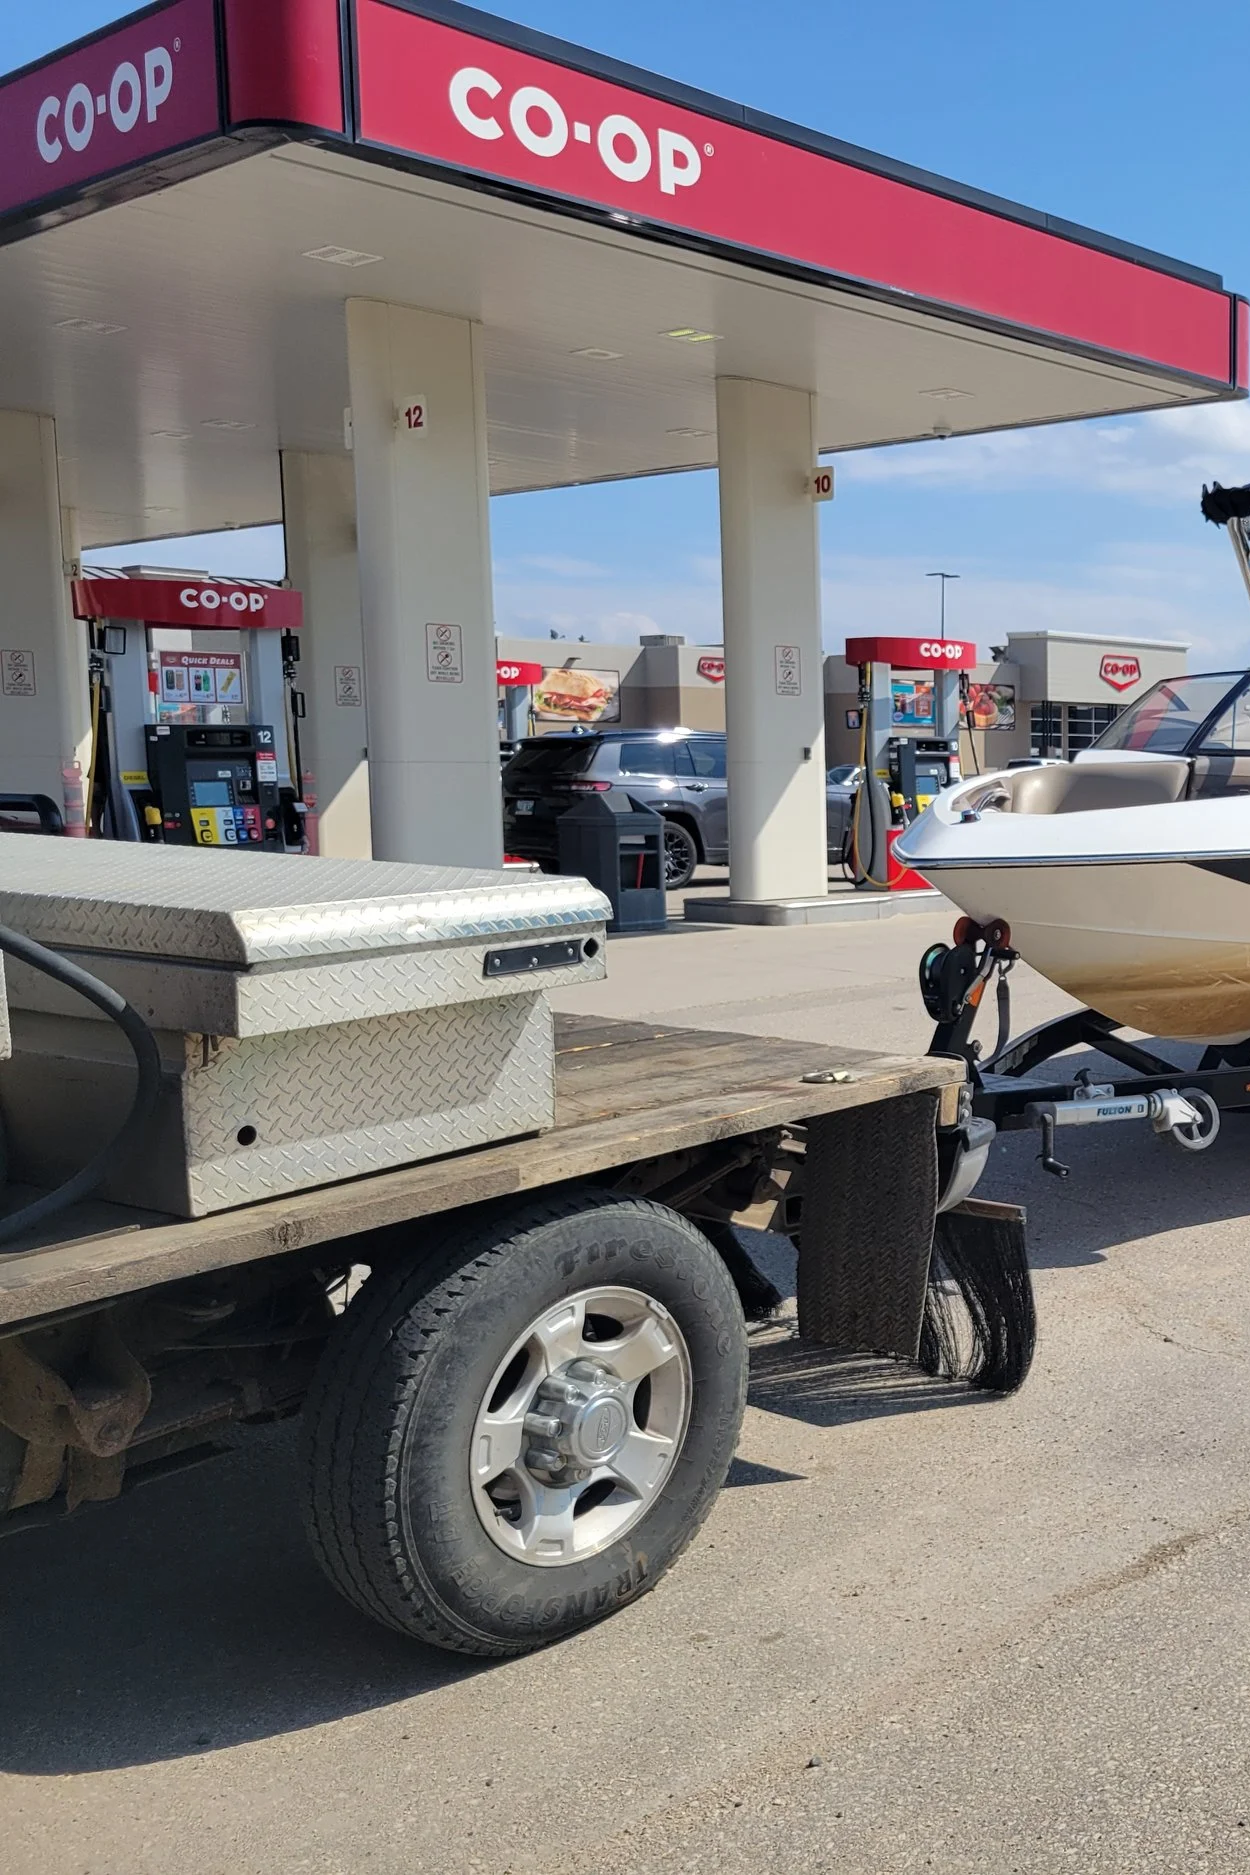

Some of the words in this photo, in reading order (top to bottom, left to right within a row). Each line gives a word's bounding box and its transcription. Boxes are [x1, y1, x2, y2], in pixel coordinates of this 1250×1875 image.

[405, 405, 424, 429] 12
[814, 475, 831, 494] 10
[1103, 662, 1137, 676] CO-OP
[257, 730, 272, 744] 12
[1096, 1104, 1132, 1117] FULTON
